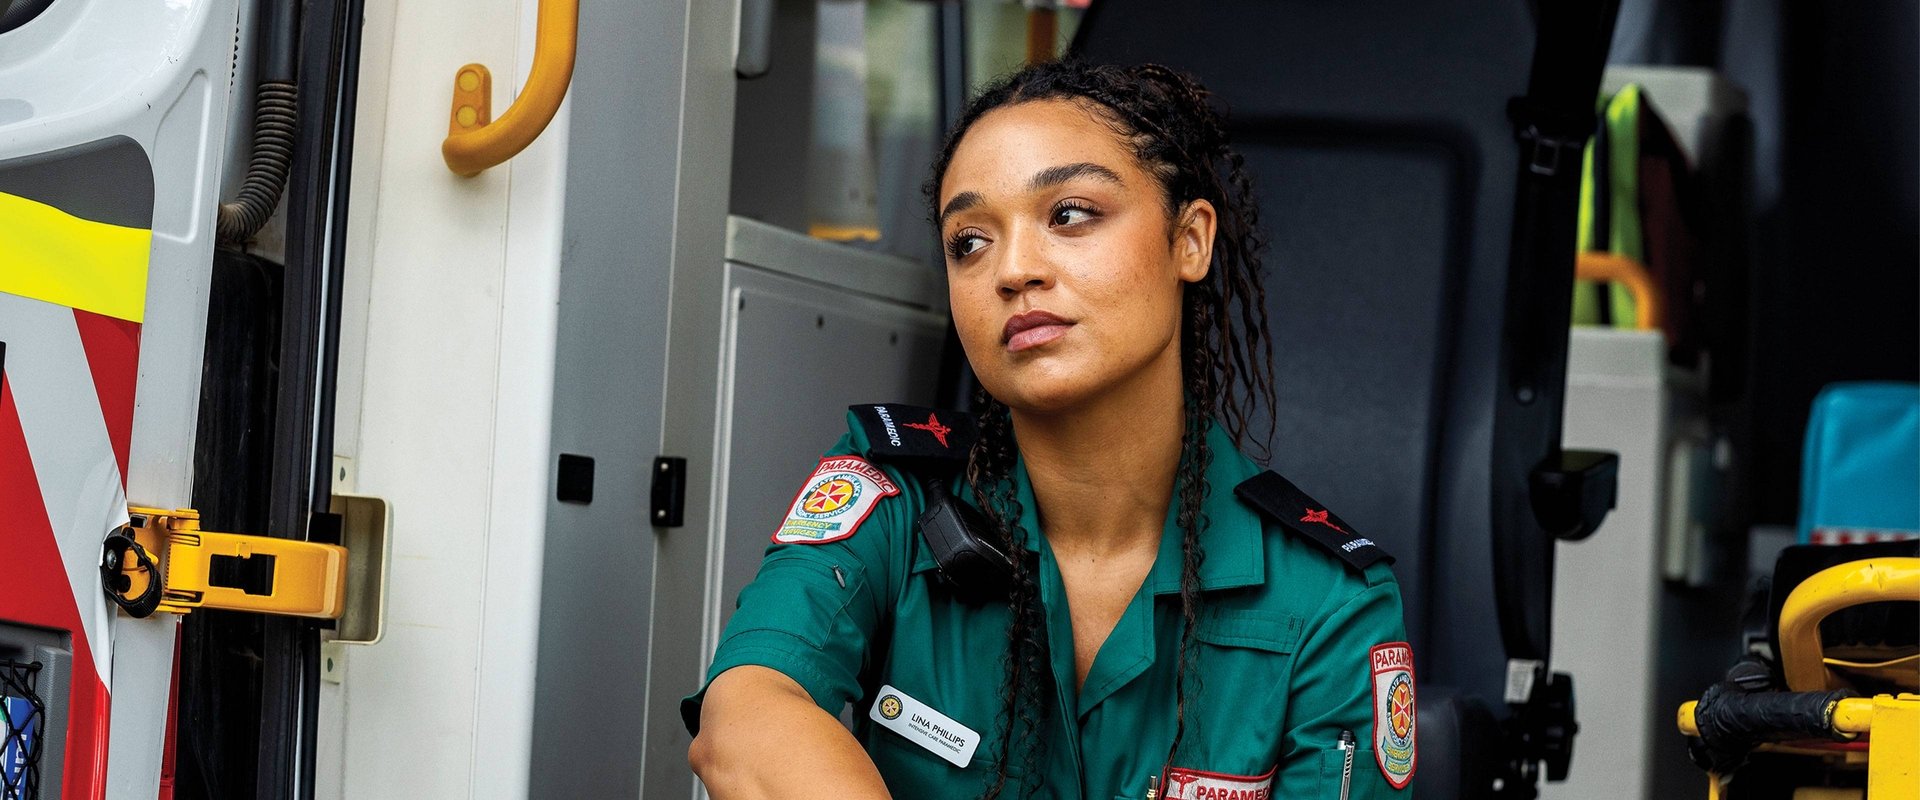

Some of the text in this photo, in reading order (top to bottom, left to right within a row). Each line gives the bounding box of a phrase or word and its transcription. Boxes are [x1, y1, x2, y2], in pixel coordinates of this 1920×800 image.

[873, 405, 901, 447] PARAMEDIC
[820, 460, 894, 491] PARAMEDIC
[908, 722, 961, 754] INTENSIVE CARE PARAMEDIC
[911, 713, 966, 748] LINA PHILLIPS
